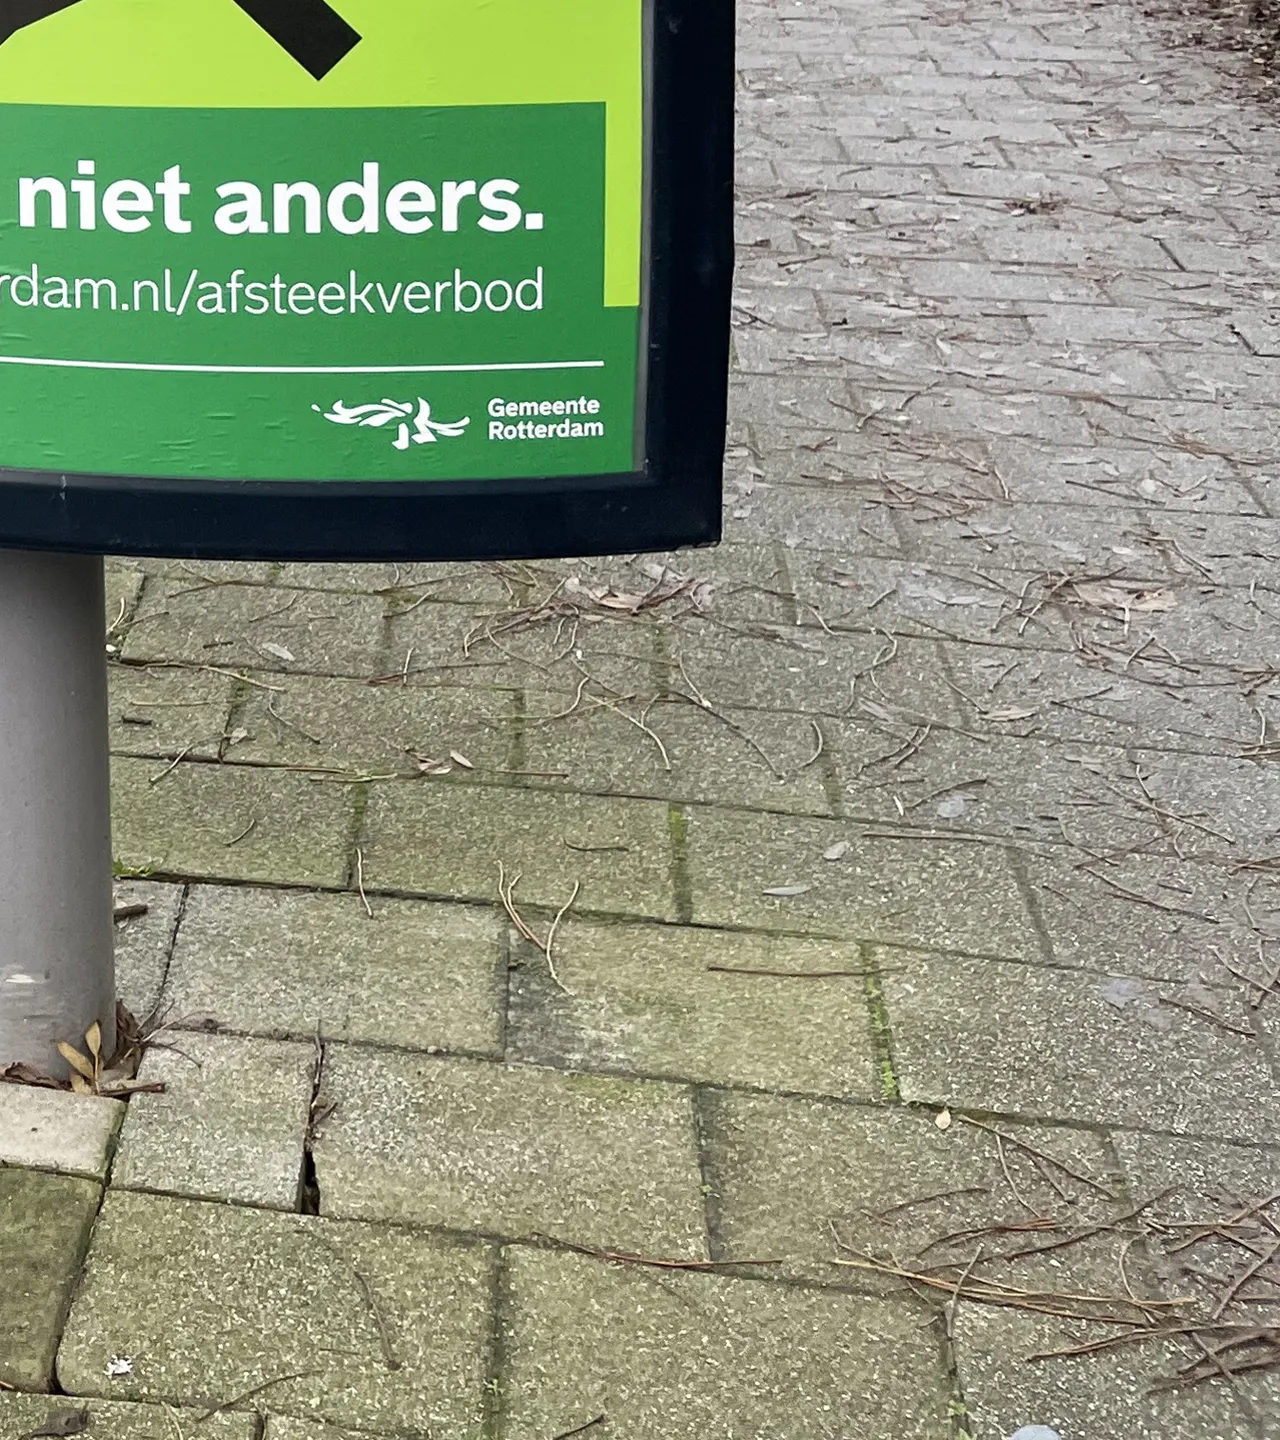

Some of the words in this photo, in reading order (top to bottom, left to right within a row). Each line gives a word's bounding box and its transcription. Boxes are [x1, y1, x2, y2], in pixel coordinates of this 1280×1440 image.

[18, 160, 192, 232] niet
[214, 162, 543, 234] anders.
[487, 396, 601, 417] Gemeente
[488, 419, 604, 441] Rotterdam
